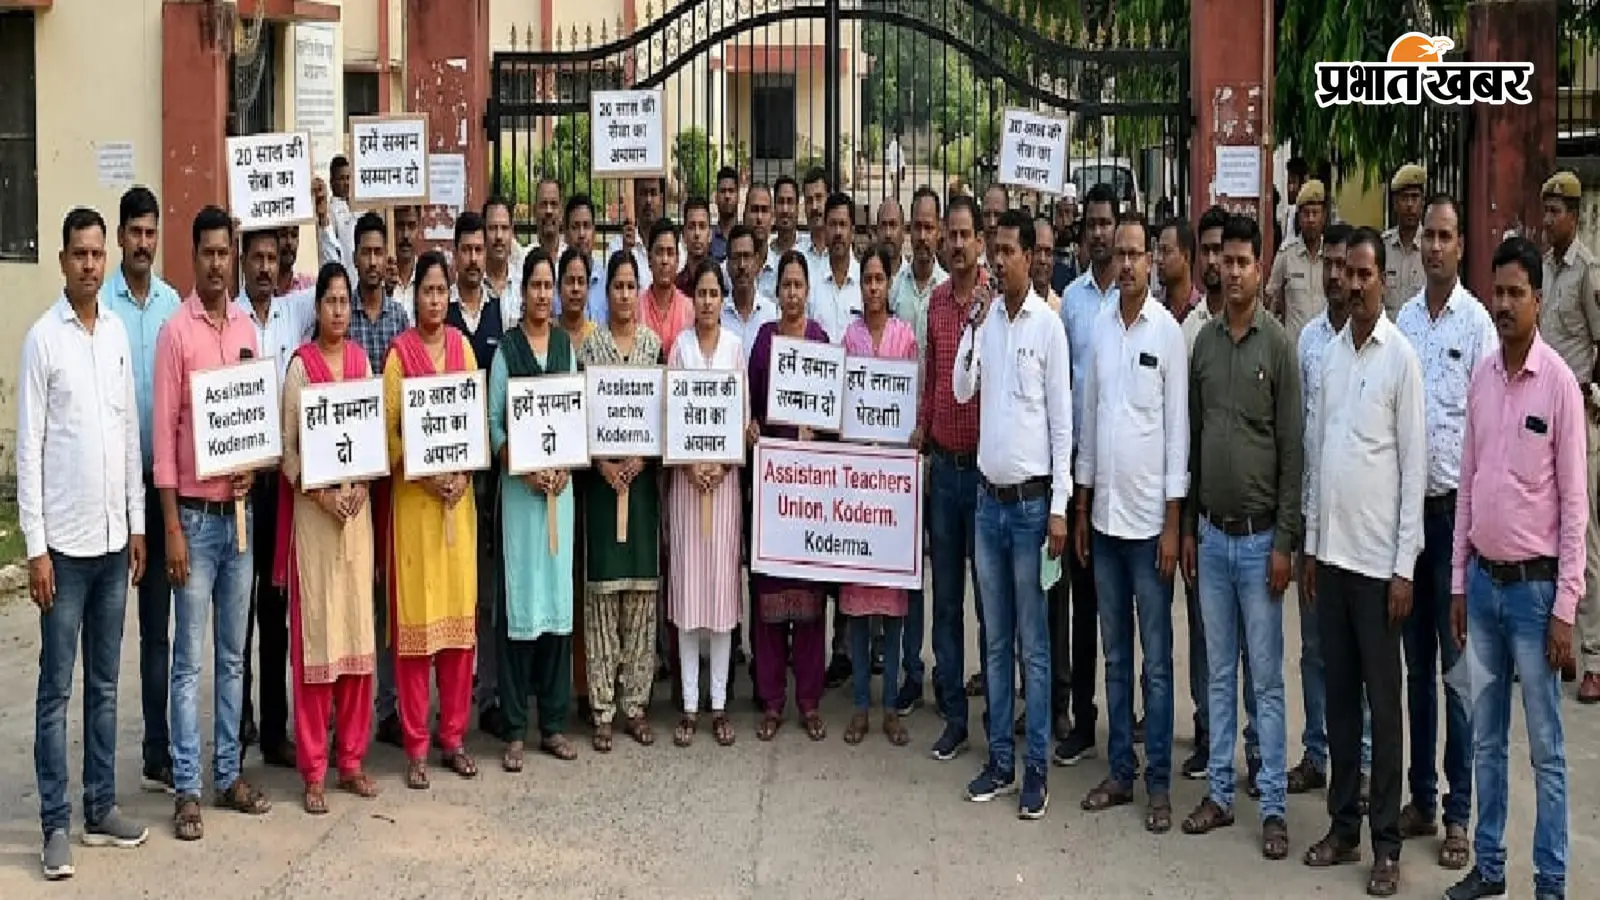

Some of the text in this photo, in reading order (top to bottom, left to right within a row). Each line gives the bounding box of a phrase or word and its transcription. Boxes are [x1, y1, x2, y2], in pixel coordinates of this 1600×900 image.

[234, 148, 252, 166] 20
[286, 135, 303, 159] की
[276, 170, 294, 189] का
[405, 159, 419, 188] दो
[205, 377, 266, 404] Assistant
[428, 387, 457, 405] साल
[458, 378, 477, 402] की
[821, 390, 836, 417] दो
[450, 413, 468, 431] का
[335, 433, 353, 464] दो
[541, 424, 557, 456] दो
[764, 458, 911, 494] Assistant Teachers
[778, 494, 828, 524] Union,
[804, 530, 873, 556] Koderma.
